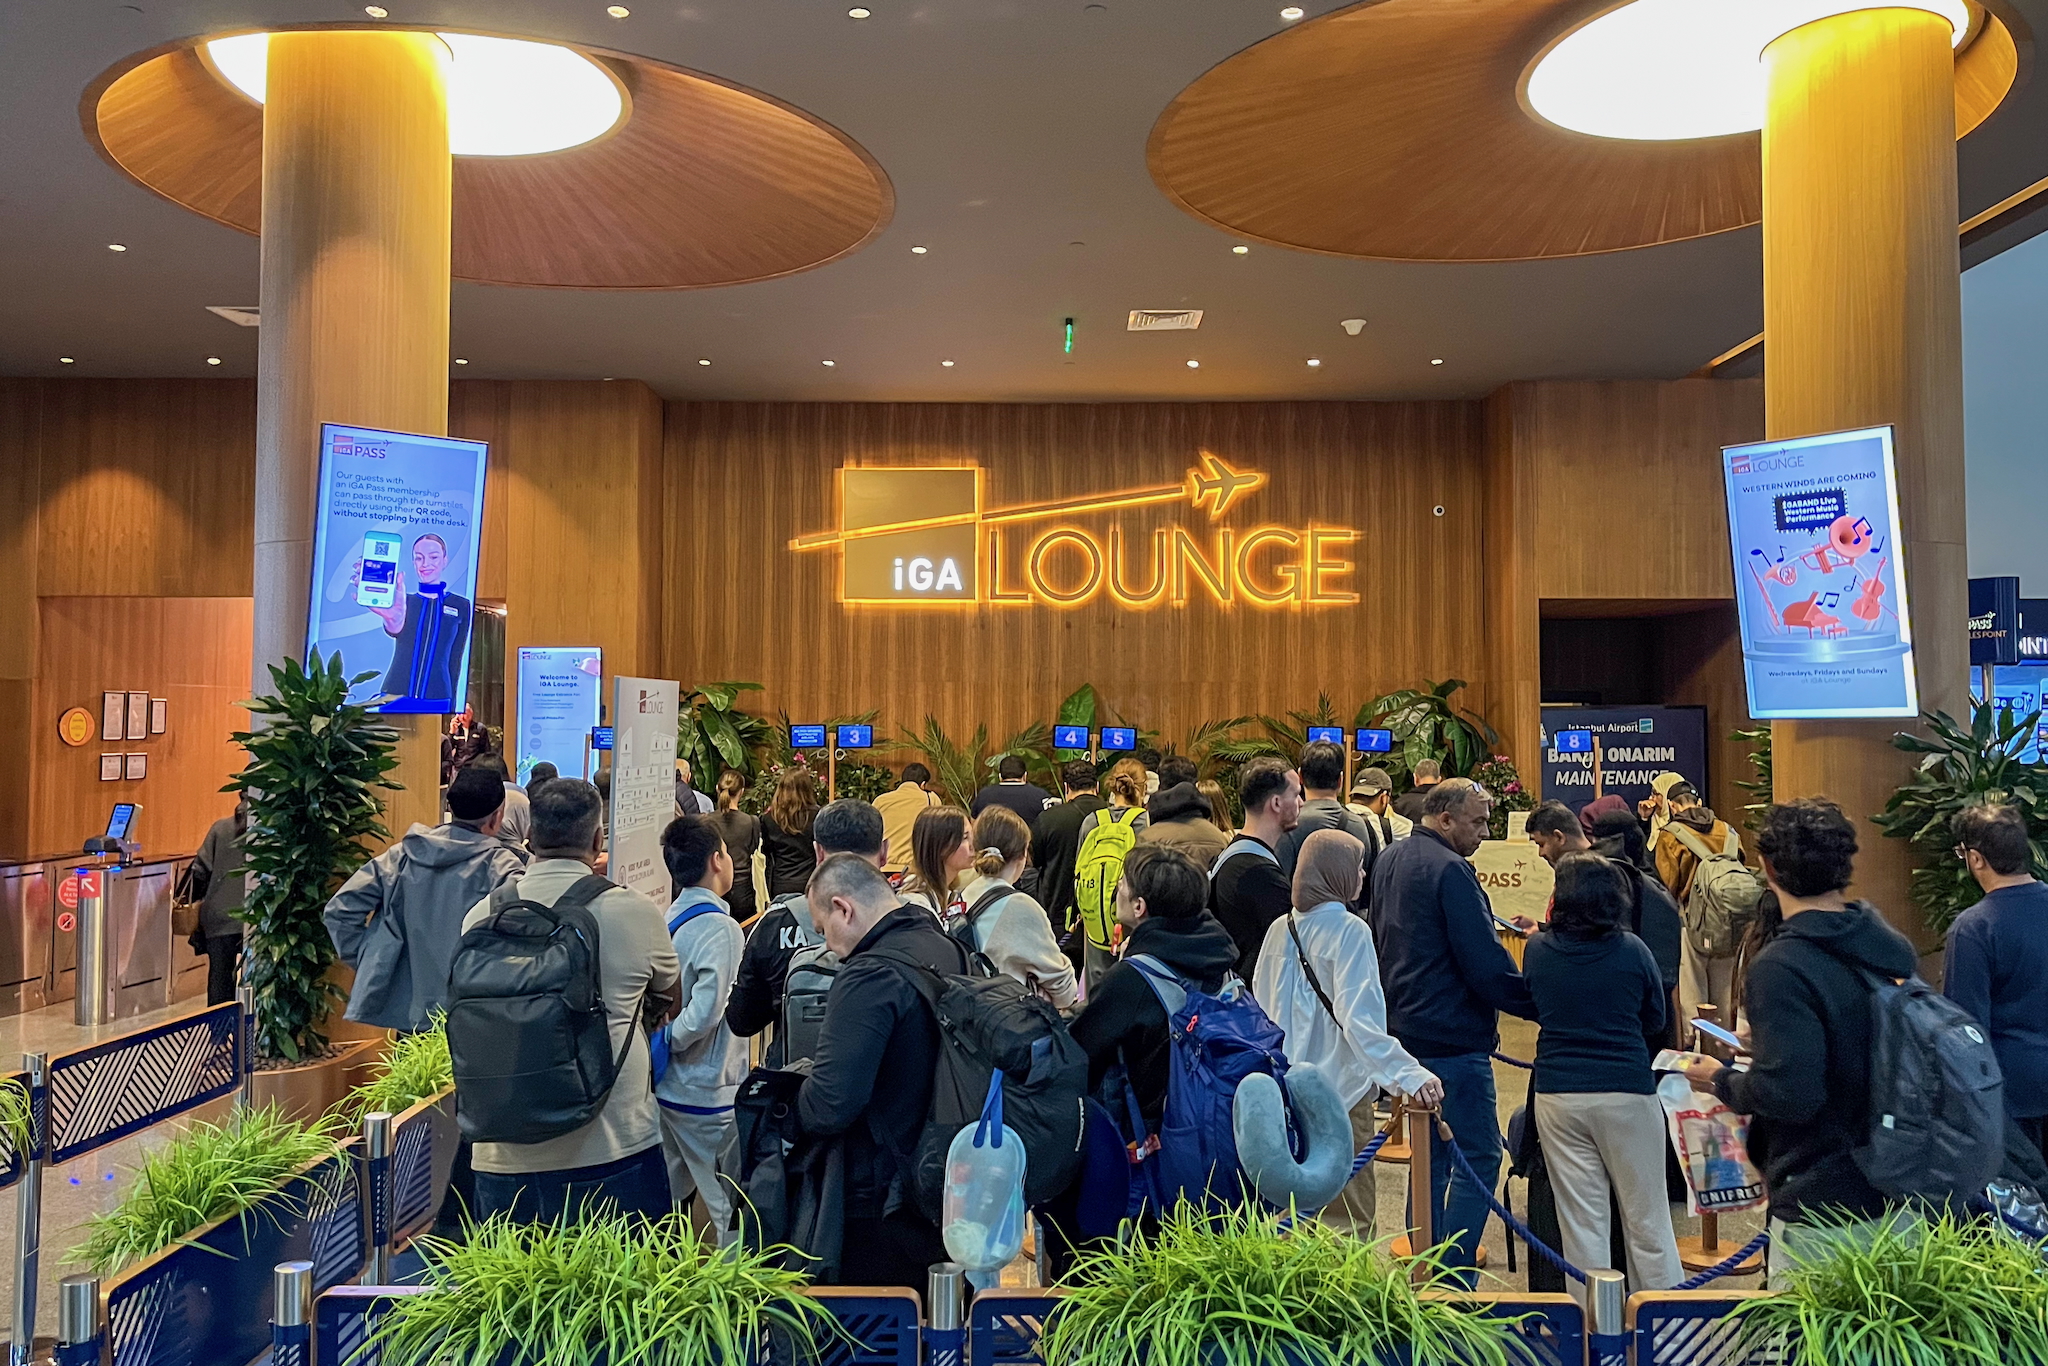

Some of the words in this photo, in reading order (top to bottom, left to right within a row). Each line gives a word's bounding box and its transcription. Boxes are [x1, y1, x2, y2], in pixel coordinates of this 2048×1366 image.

[355, 446, 386, 459] PASS
[1752, 455, 1805, 473] LOUNGE
[336, 470, 353, 480] Our
[355, 473, 384, 483] guests
[386, 476, 404, 485] with
[1742, 481, 1784, 493] WESTERN
[1784, 477, 1815, 488] WINDS
[1817, 475, 1835, 485] ARE
[1836, 471, 1877, 483] COMING
[348, 481, 364, 490] iGA
[366, 483, 386, 492] Pass
[387, 486, 440, 498] membership
[334, 491, 351, 499] can
[352, 493, 373, 503] pass
[374, 492, 409, 505] through
[410, 496, 424, 505] the
[425, 498, 464, 509] turnstiles
[1819, 497, 1837, 505] Live
[334, 500, 367, 511] directly
[369, 503, 393, 513] using
[394, 504, 414, 513] their
[415, 507, 429, 516] QR
[429, 508, 452, 518] code,
[1784, 505, 1816, 516] Western
[1816, 504, 1839, 514] Music
[333, 508, 368, 519] without
[369, 511, 407, 524] stopping
[408, 515, 420, 525] by
[420, 516, 430, 524] at
[431, 517, 445, 526] the
[446, 518, 468, 528] desk.
[1786, 512, 1835, 523] Performance
[894, 557, 963, 592] iGA
[988, 527, 1362, 605] LOUNGE
[1968, 618, 1992, 630] PASS
[1969, 630, 1981, 639] LES
[1982, 629, 2007, 638] POINT
[1768, 669, 1813, 678] Wednesdays,
[1814, 668, 1840, 676] Fridays
[1856, 666, 1888, 676] Sundays
[1607, 723, 1639, 734] Airport
[849, 729, 860, 744] 3
[1065, 730, 1077, 745] 4
[1112, 731, 1124, 746] 5
[1320, 731, 1331, 742] 6
[1368, 733, 1379, 747] 7
[1569, 734, 1580, 749] 8
[1607, 746, 1675, 763] ONARIM
[1555, 769, 1670, 786] MAINTENANC
[1477, 872, 1522, 888] PASS
[780, 925, 808, 949] KA
